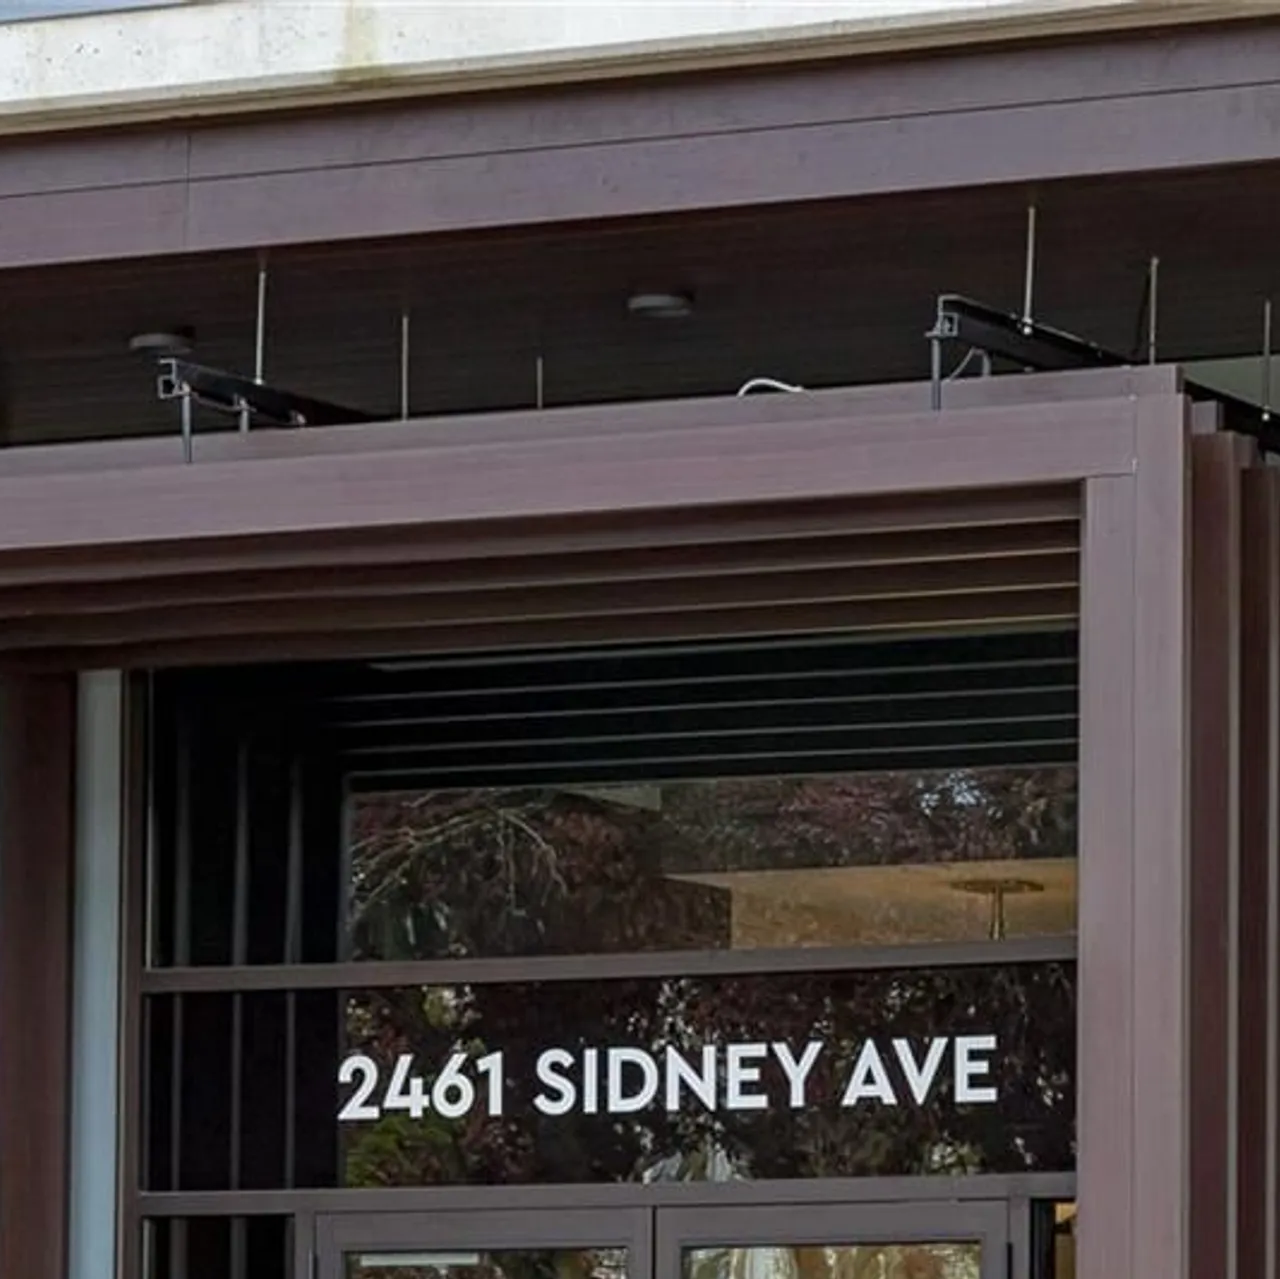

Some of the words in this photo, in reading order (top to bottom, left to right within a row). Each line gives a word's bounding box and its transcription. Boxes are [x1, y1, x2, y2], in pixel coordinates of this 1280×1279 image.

[336, 1049, 505, 1121] 2461
[532, 1039, 824, 1117] SIDNEY
[839, 1034, 998, 1107] AVE
